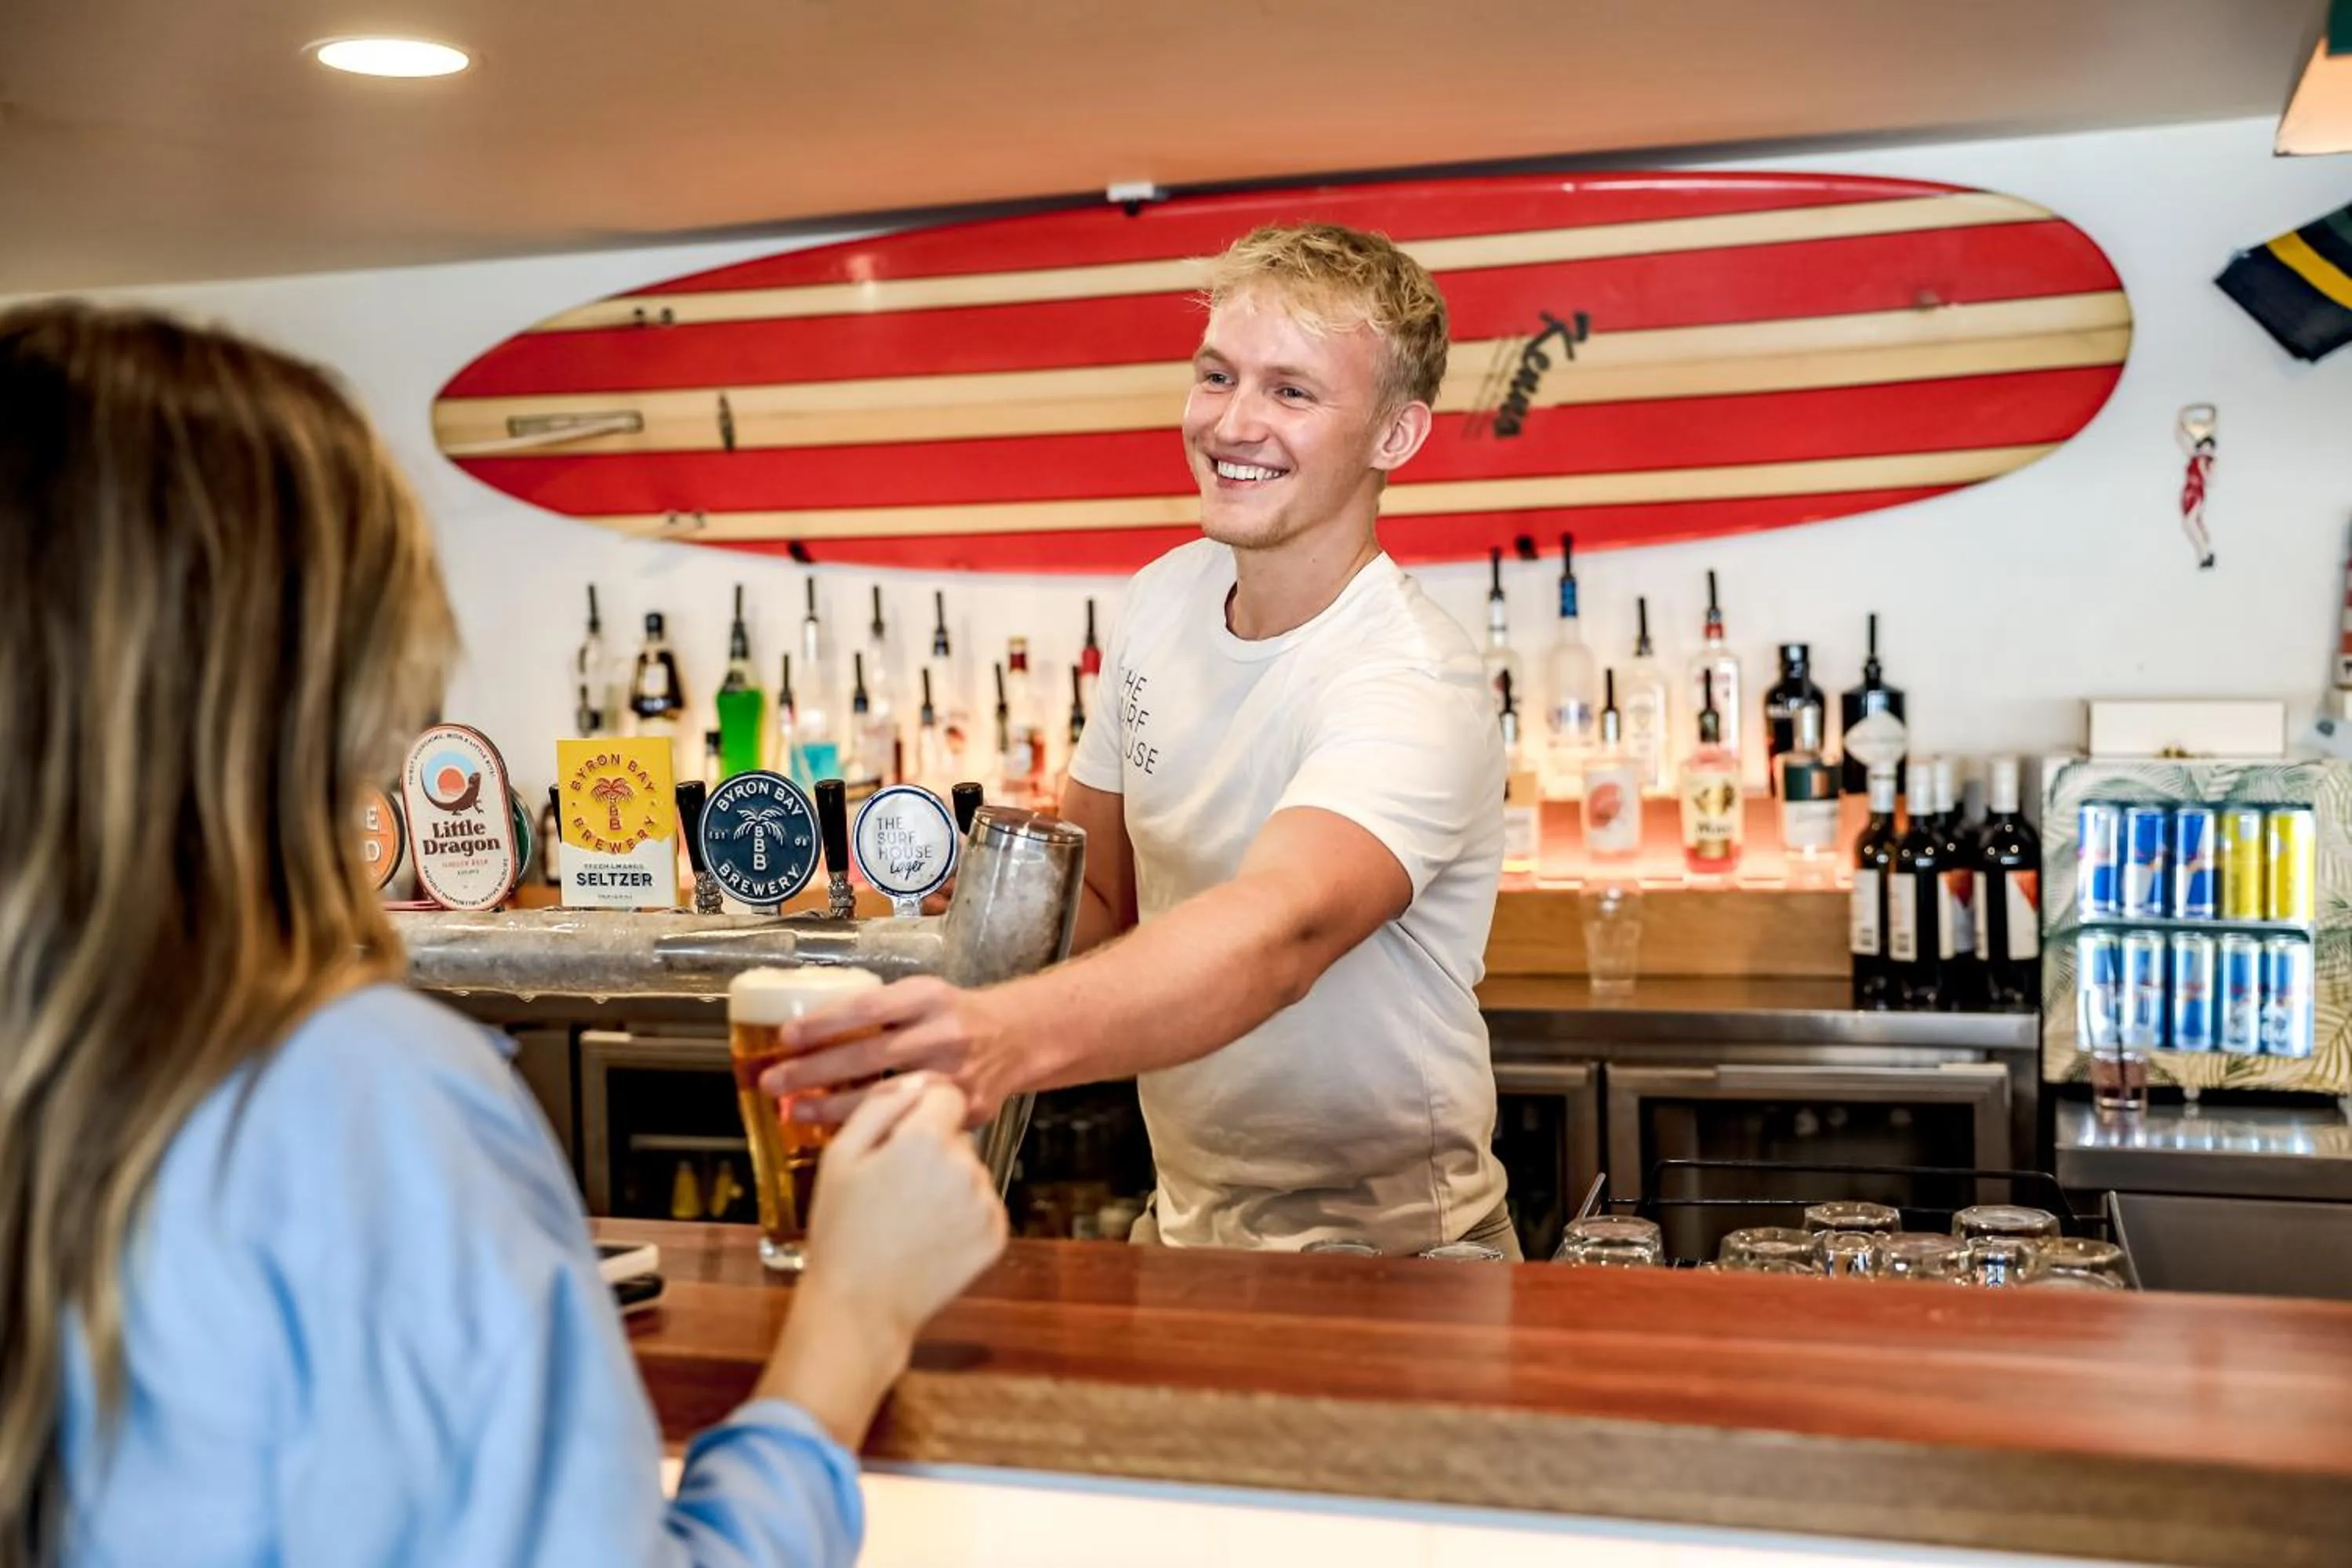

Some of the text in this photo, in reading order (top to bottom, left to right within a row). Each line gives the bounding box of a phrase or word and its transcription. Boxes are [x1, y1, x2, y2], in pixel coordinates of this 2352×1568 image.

[1120, 666, 1148, 702] HE
[571, 753, 655, 792] BYRON BAY
[716, 782, 804, 816] BYRON BAY
[432, 819, 486, 838] Little
[877, 817, 903, 830] THE
[573, 815, 655, 854] BREWERY
[877, 830, 916, 845] SURF
[423, 838, 501, 857] Dragon
[878, 844, 933, 860] HOUSE
[890, 858, 926, 880] Lager
[576, 873, 653, 886] SELTZER
[718, 863, 800, 896] BREWERY
